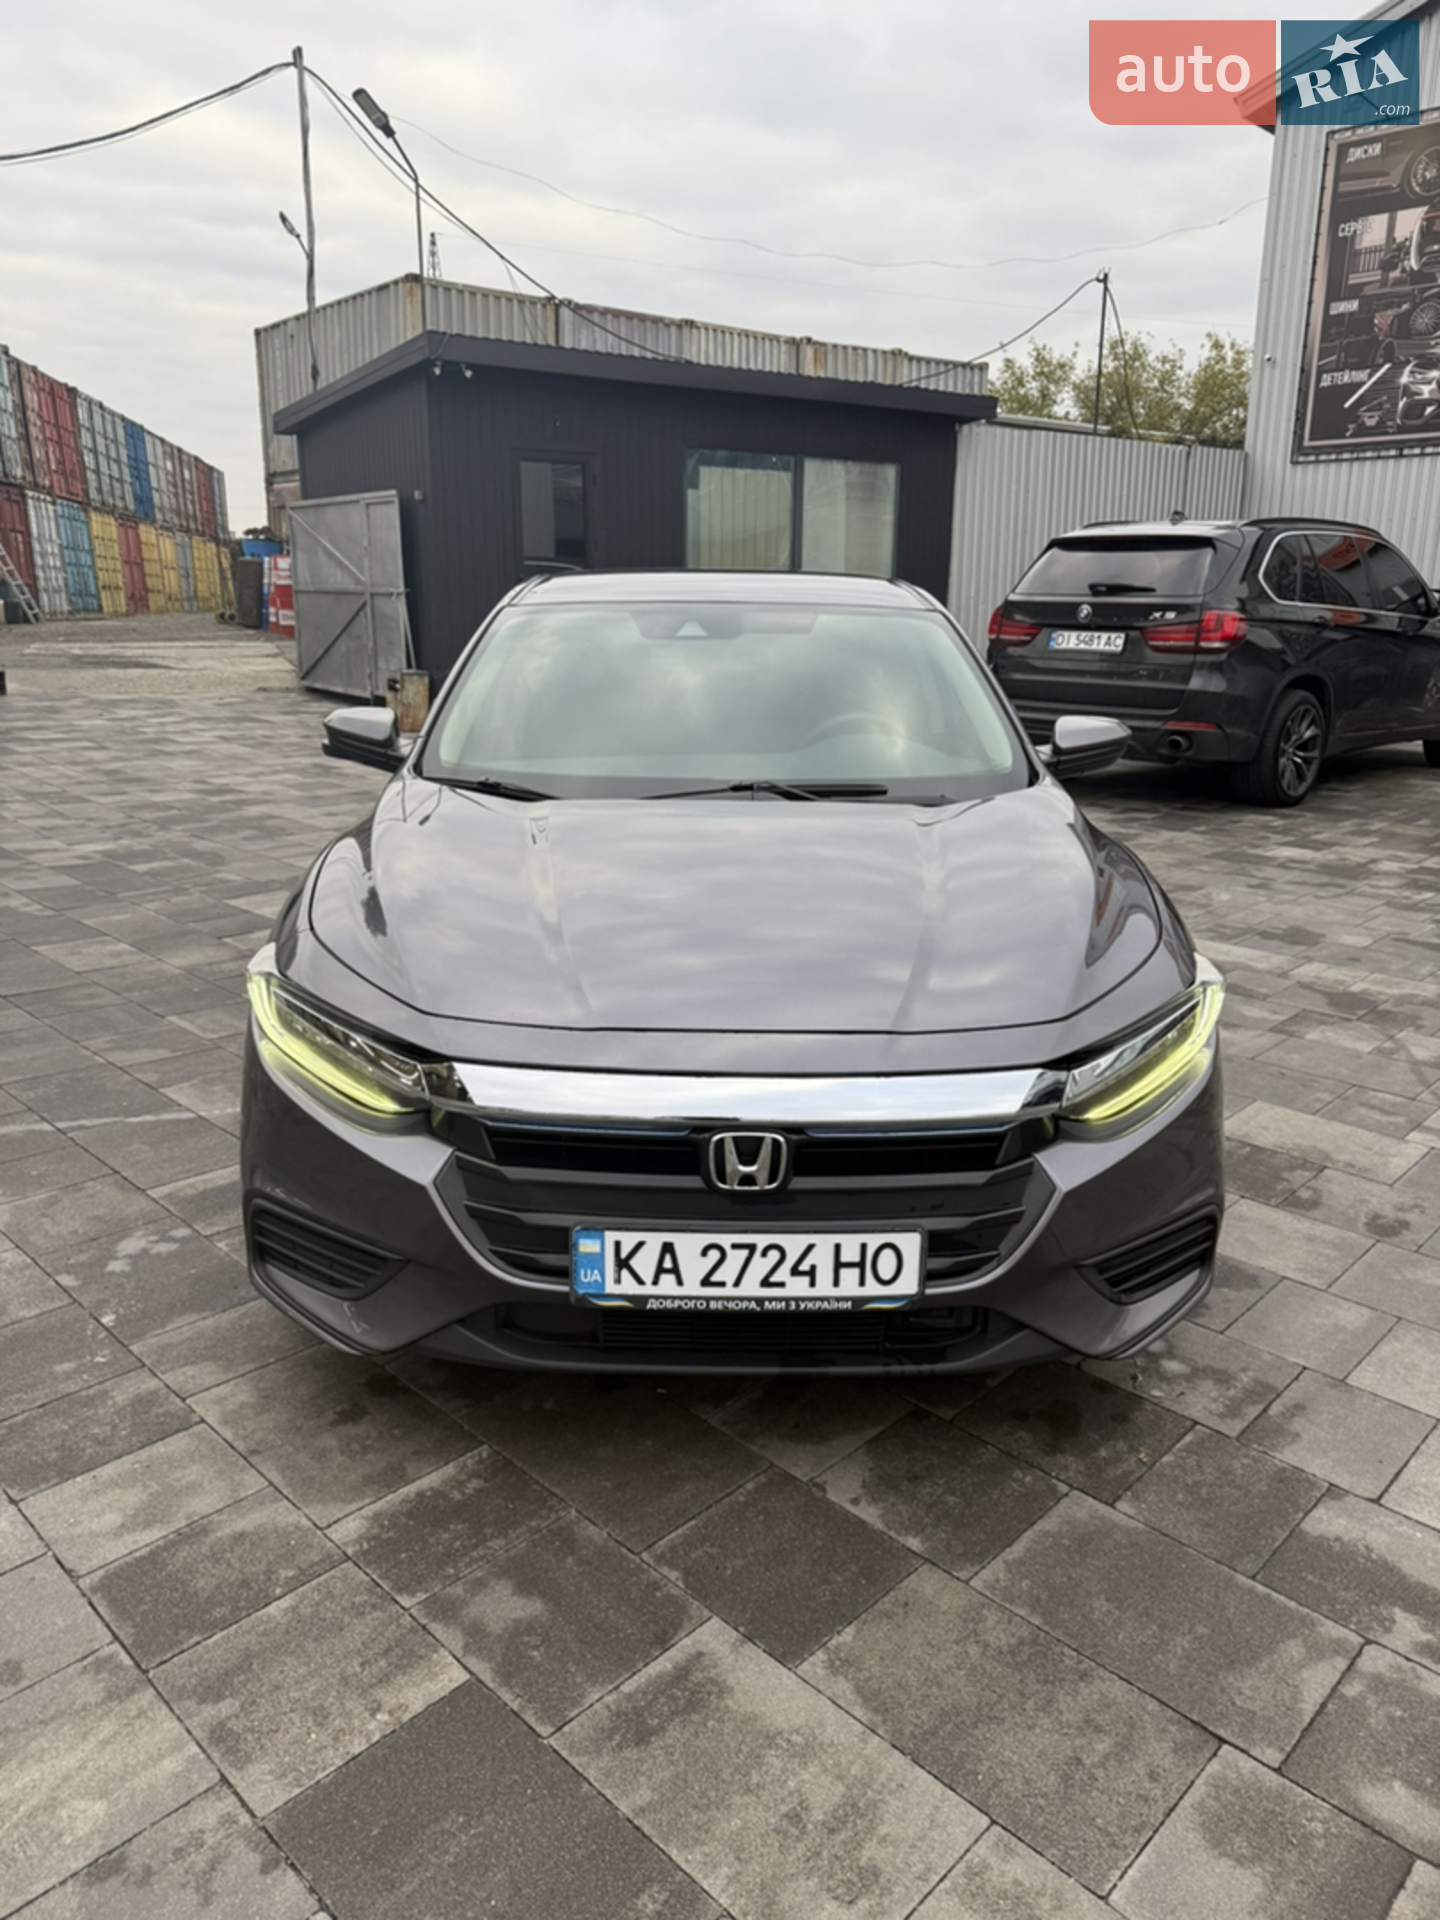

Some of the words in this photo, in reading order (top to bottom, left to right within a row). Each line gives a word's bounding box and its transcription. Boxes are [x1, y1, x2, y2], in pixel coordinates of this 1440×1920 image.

[1346, 142, 1382, 164] ДИСКИ
[1074, 632, 1102, 647] 5481
[1103, 633, 1123, 649] AC
[613, 1240, 684, 1287] KA
[699, 1242, 817, 1288] 2724
[833, 1241, 904, 1288] HO
[580, 1268, 602, 1283] UA
[646, 1298, 706, 1311] ДОБРОГО
[709, 1299, 760, 1312] ВЕЧОРА,
[764, 1299, 786, 1311] МИ
[799, 1297, 852, 1311] УКРАЇНИ
